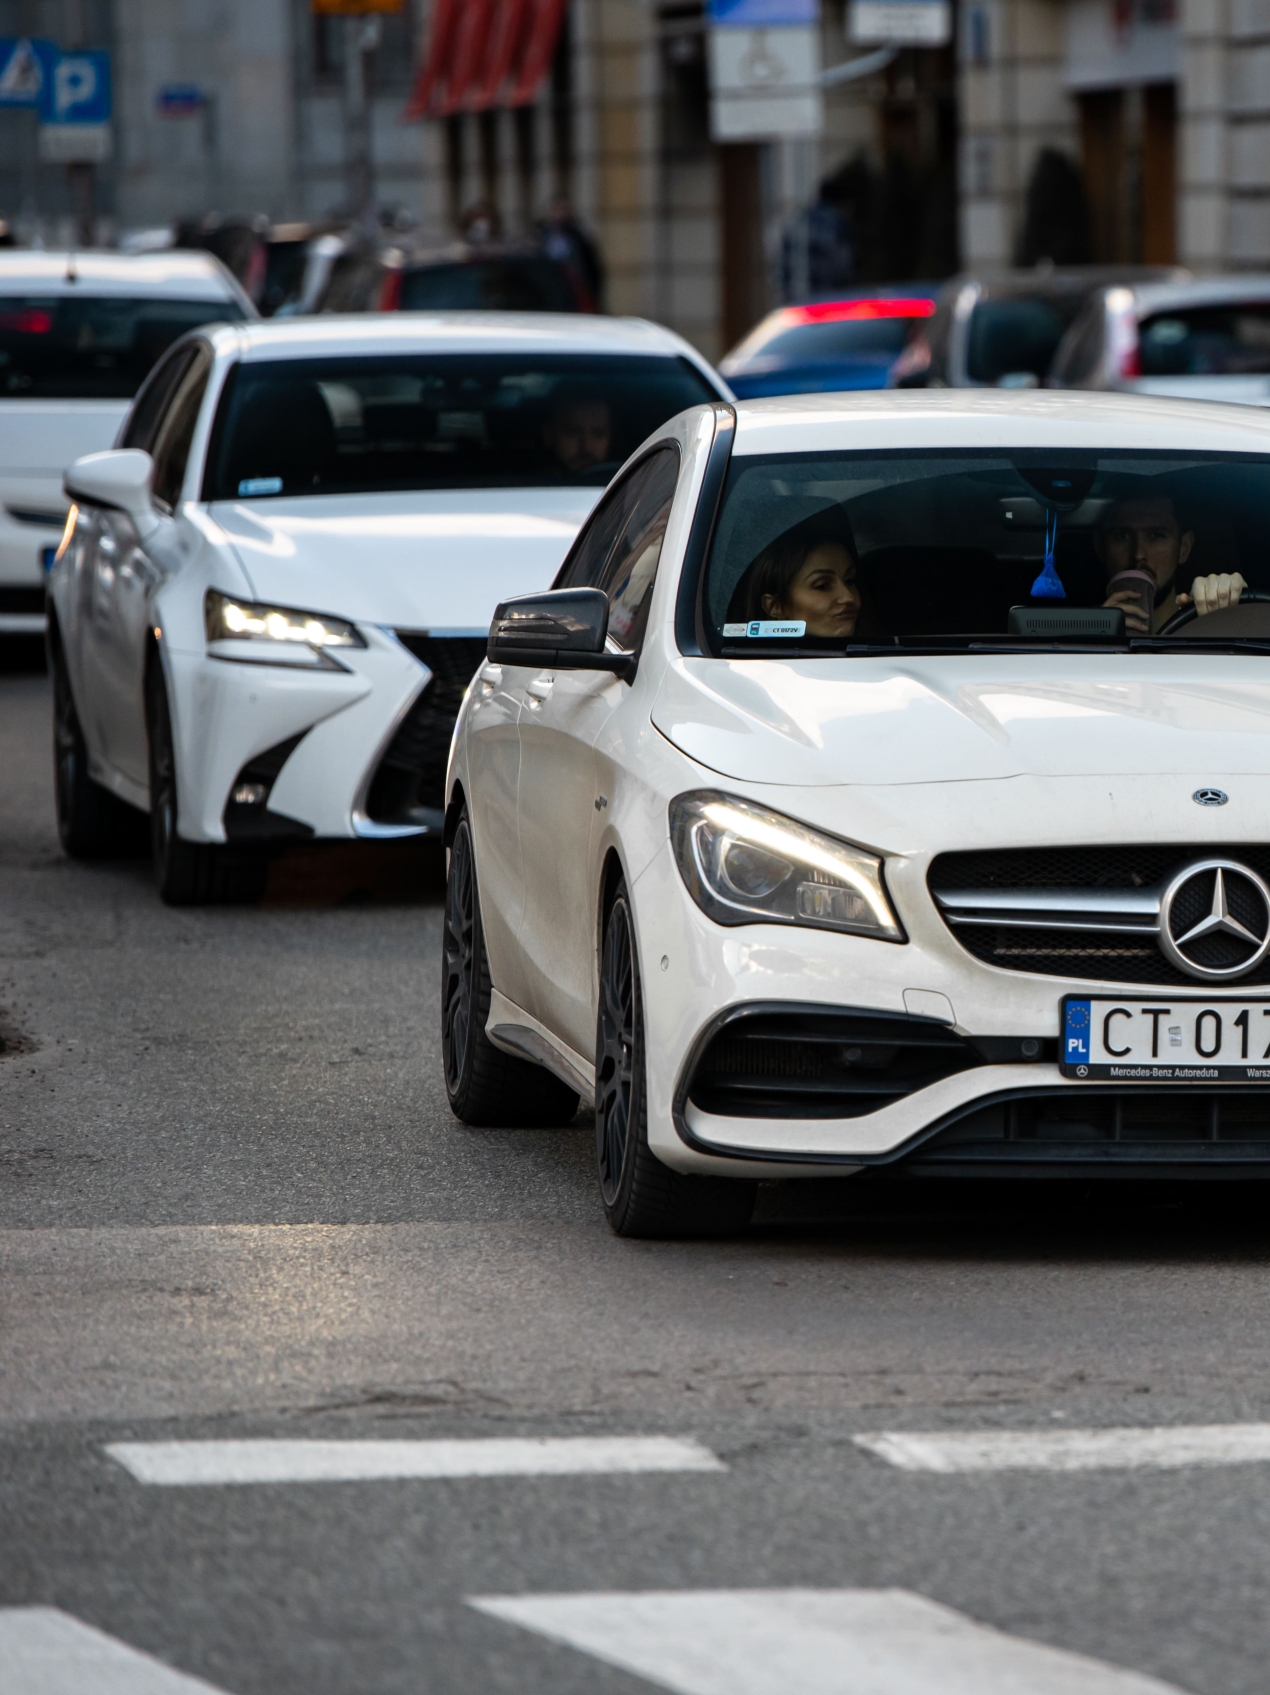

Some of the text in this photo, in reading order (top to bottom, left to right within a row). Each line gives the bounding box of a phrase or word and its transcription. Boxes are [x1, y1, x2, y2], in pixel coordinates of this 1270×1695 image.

[54, 57, 96, 119] P
[1067, 1038, 1087, 1053] PL
[1103, 1007, 1171, 1058] CT
[1110, 1066, 1219, 1078] Mercedes-Benz Autoreduta
